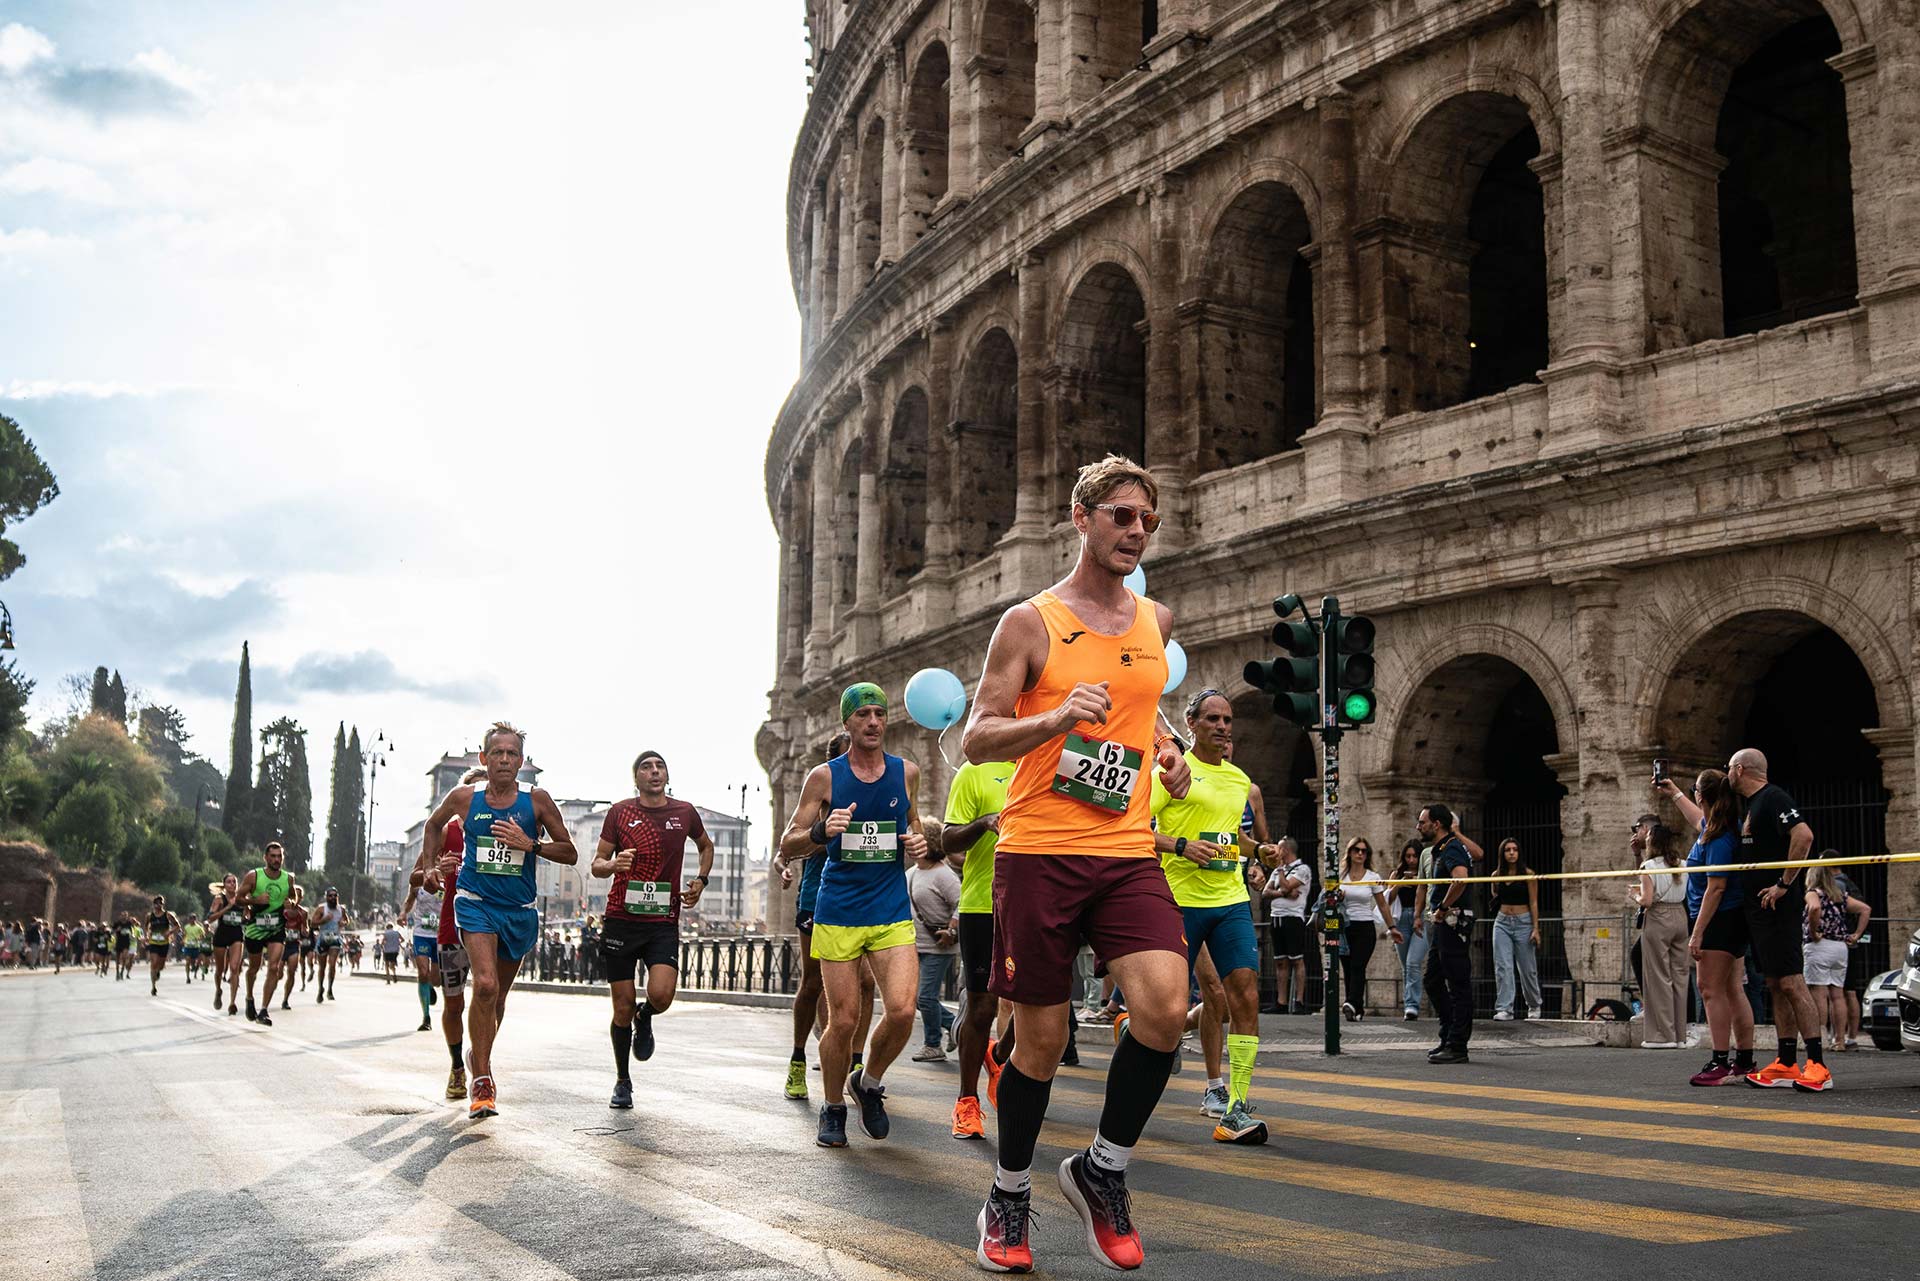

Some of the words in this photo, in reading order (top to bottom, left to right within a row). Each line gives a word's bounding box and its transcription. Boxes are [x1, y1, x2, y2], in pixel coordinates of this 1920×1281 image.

[1074, 758, 1131, 793] 2482
[862, 836, 877, 845] 733
[488, 849, 511, 863] 945
[1212, 851, 1237, 860] ABRIZIO
[643, 893, 655, 901] 781
[1093, 1146, 1116, 1165] OME
